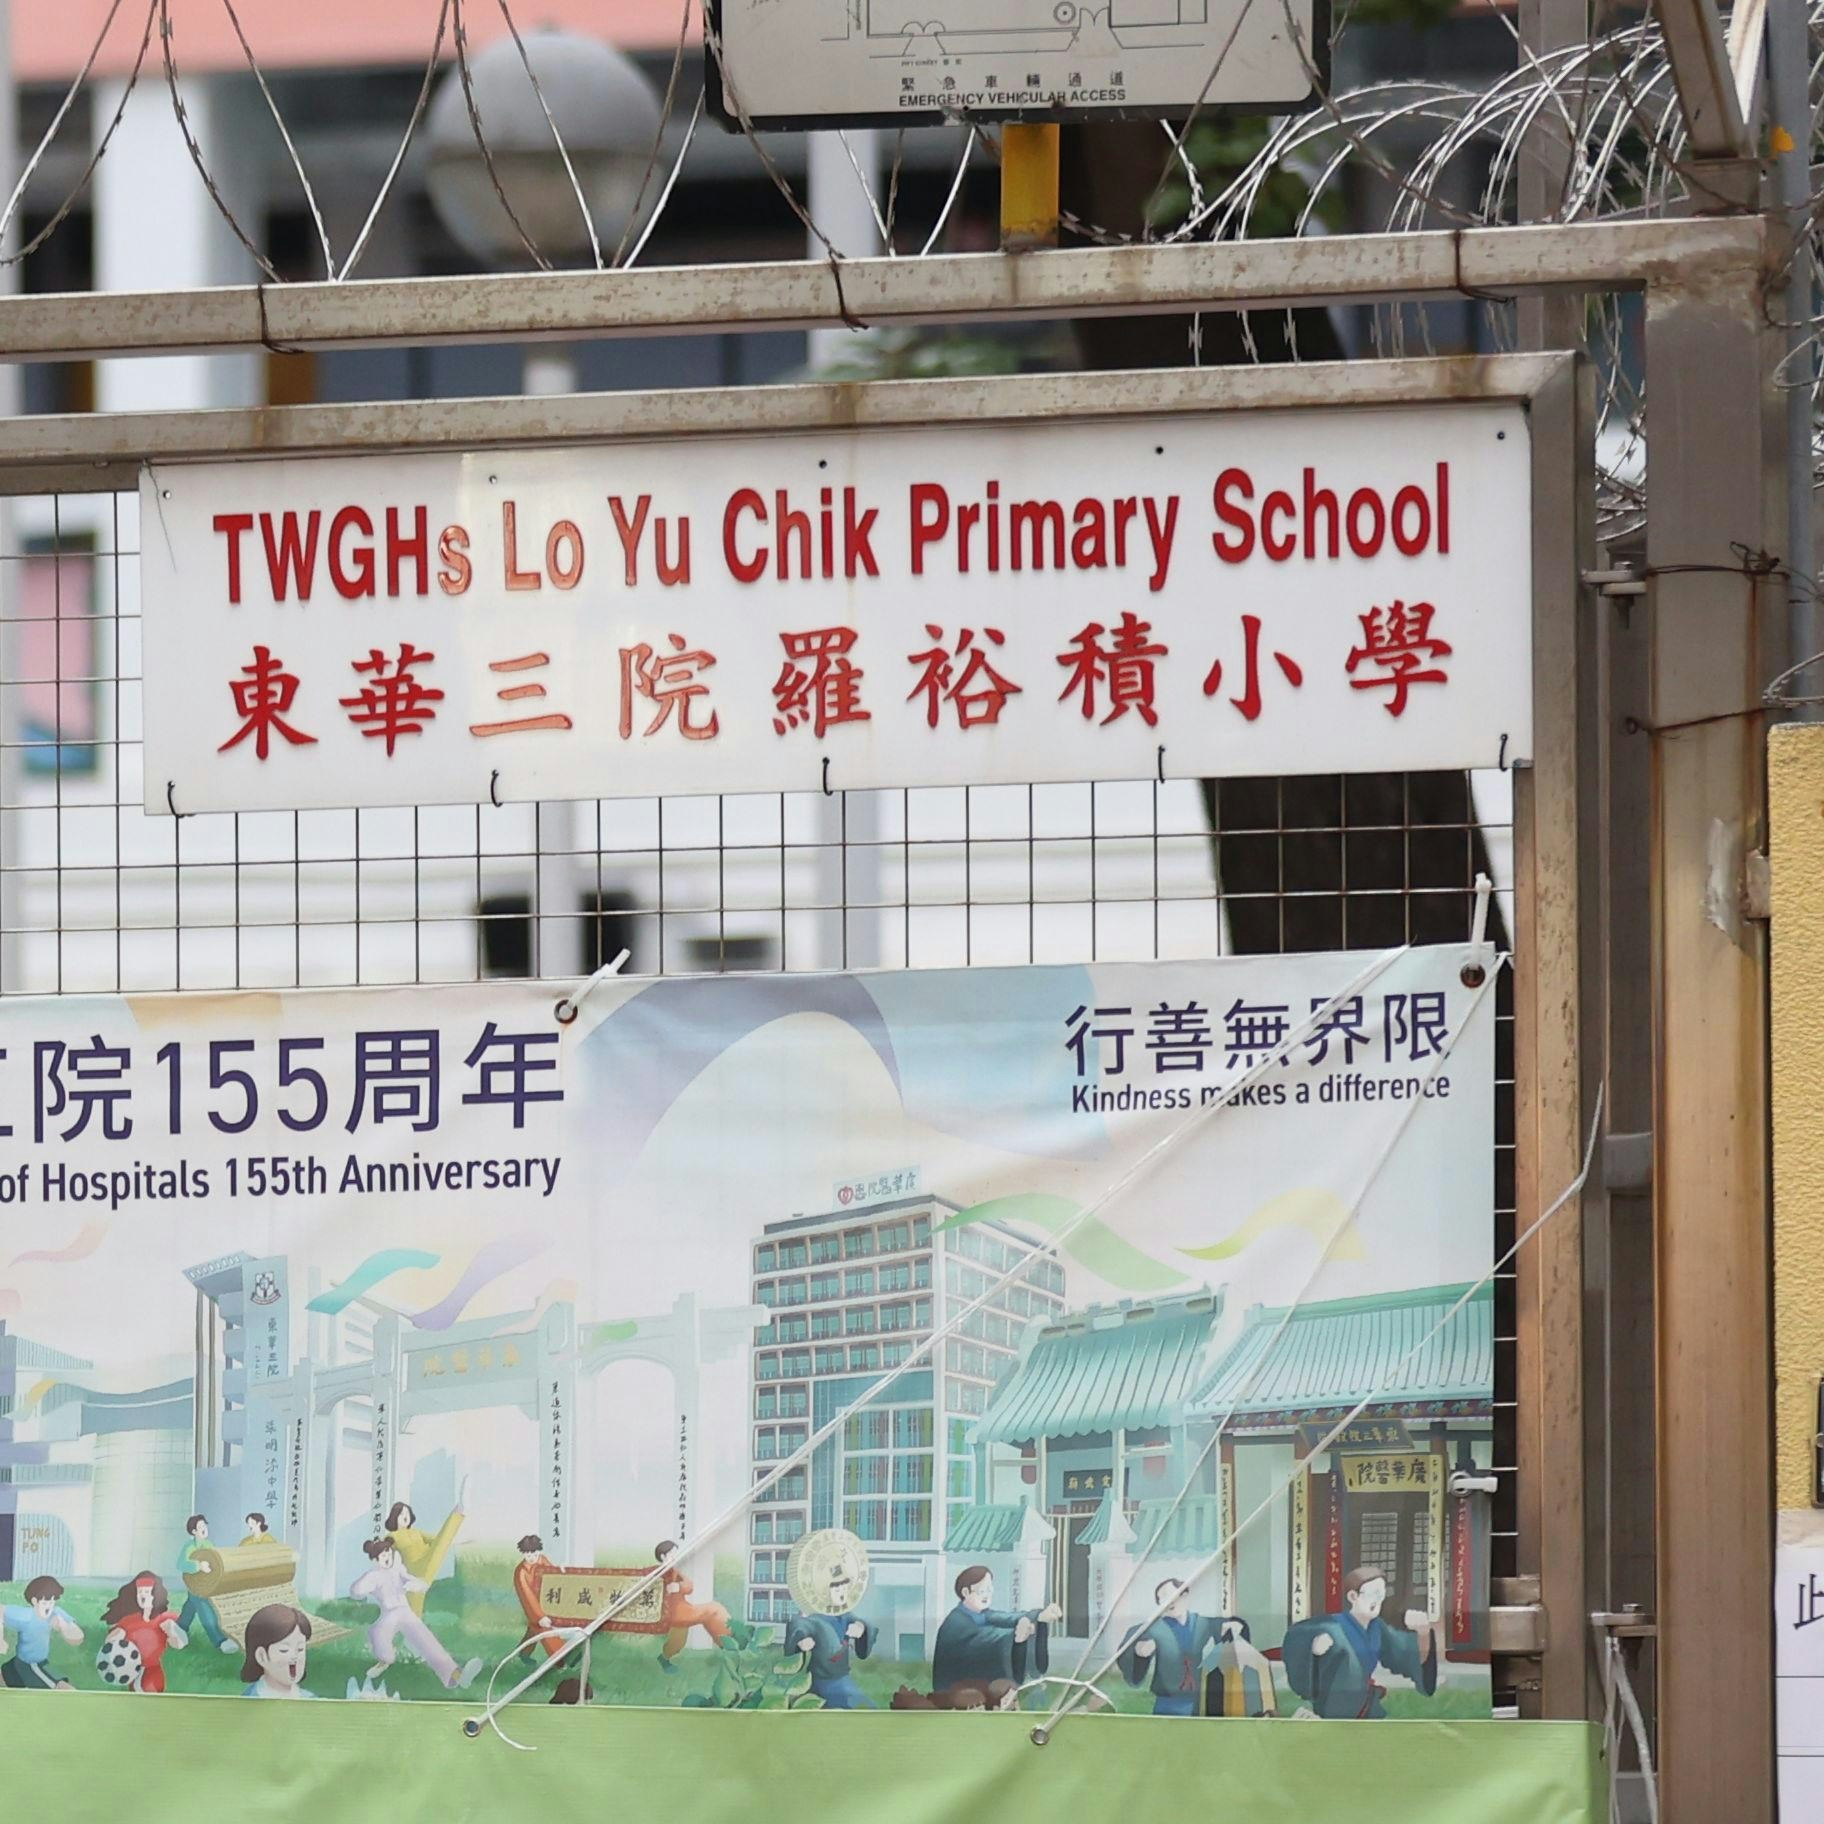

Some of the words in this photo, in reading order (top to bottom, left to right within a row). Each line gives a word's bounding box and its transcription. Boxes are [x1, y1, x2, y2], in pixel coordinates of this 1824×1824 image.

[899, 92, 984, 107] EMERGENCY
[987, 90, 1066, 105] VEHICULAR
[1069, 88, 1126, 103] ACCESS
[901, 71, 1125, 92] 緊急車輛通道
[213, 501, 473, 605] TWGHs
[502, 499, 585, 595] Lo
[607, 491, 692, 590] Yu
[721, 485, 881, 584] Chik
[909, 479, 1180, 594] Primary
[1209, 460, 1452, 568] School
[216, 597, 1454, 761] 東華三院羅裕積小學
[1063, 991, 1452, 1078] 行善無界限
[1072, 1083, 1192, 1114] Kindness
[1295, 1078, 1311, 1104] a
[1318, 1073, 1452, 1103] difference
[41, 1158, 210, 1211] Hospitals
[225, 1156, 329, 1198] 155th
[338, 1151, 562, 1199] Anniversary
